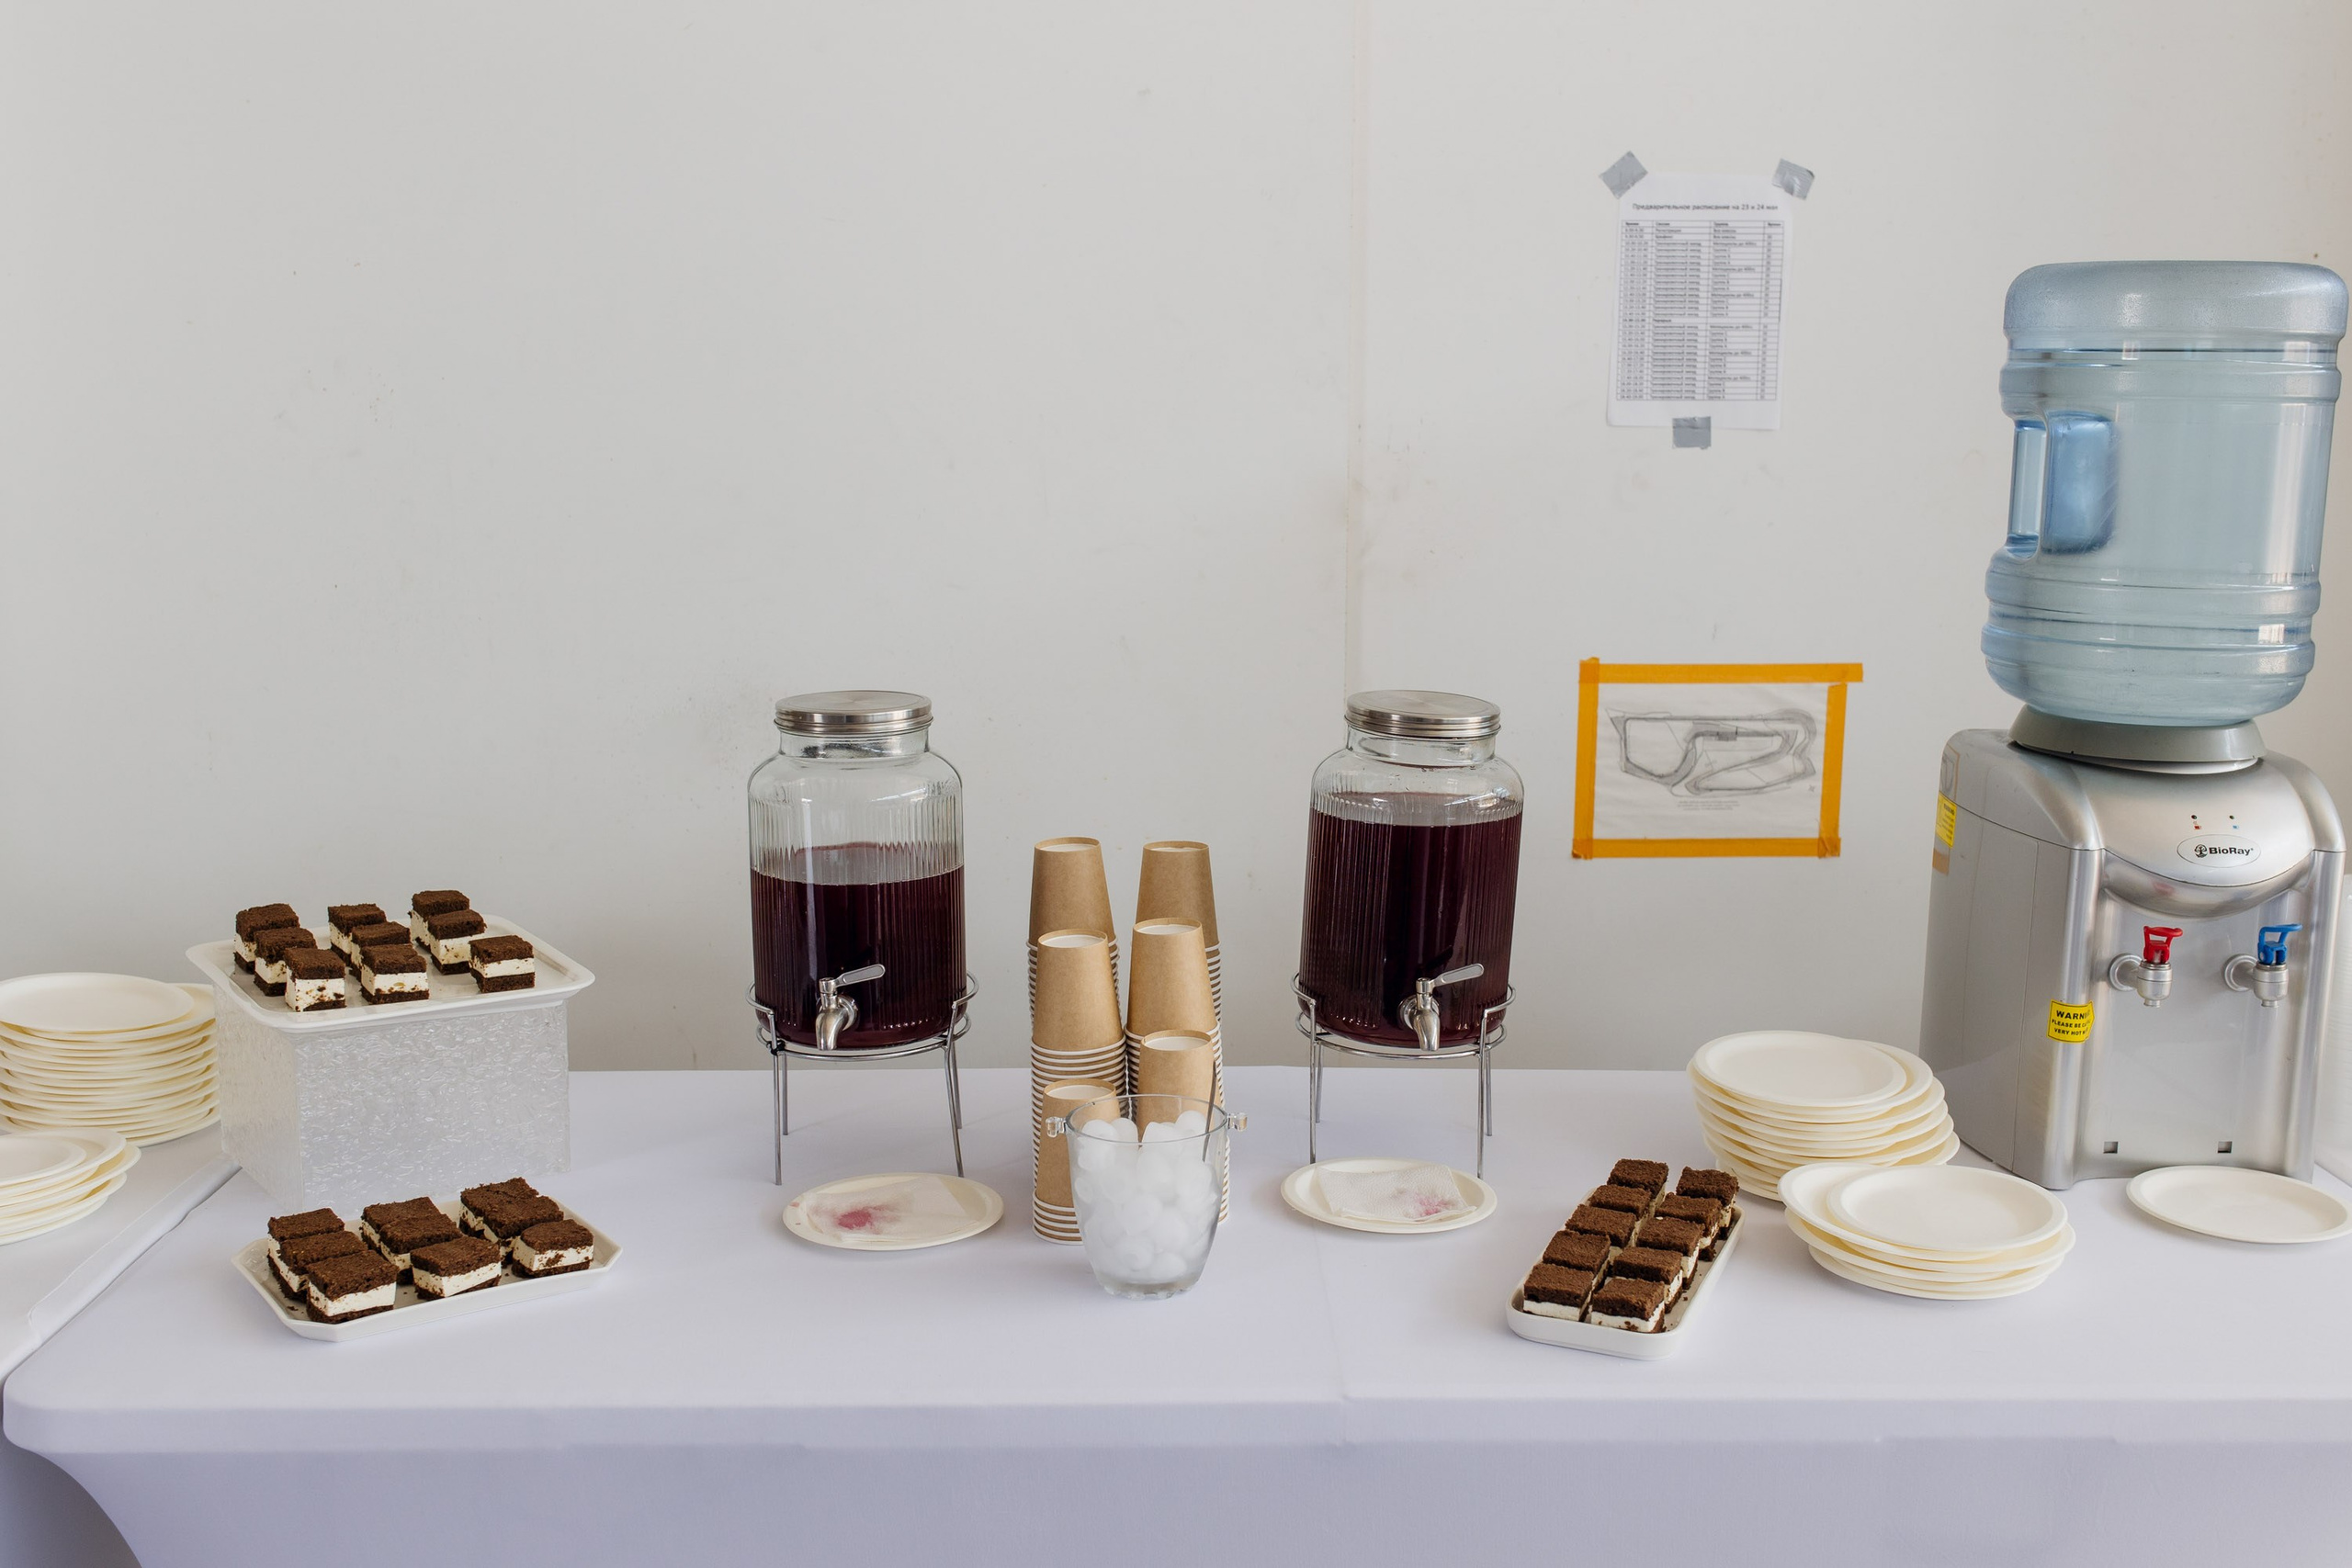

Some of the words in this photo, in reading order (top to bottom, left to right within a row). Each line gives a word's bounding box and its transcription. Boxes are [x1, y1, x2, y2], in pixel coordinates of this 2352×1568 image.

[1632, 203, 1690, 211] Предварительное
[2209, 846, 2251, 856] BioRay
[2052, 1019, 2074, 1028] PLEASE
